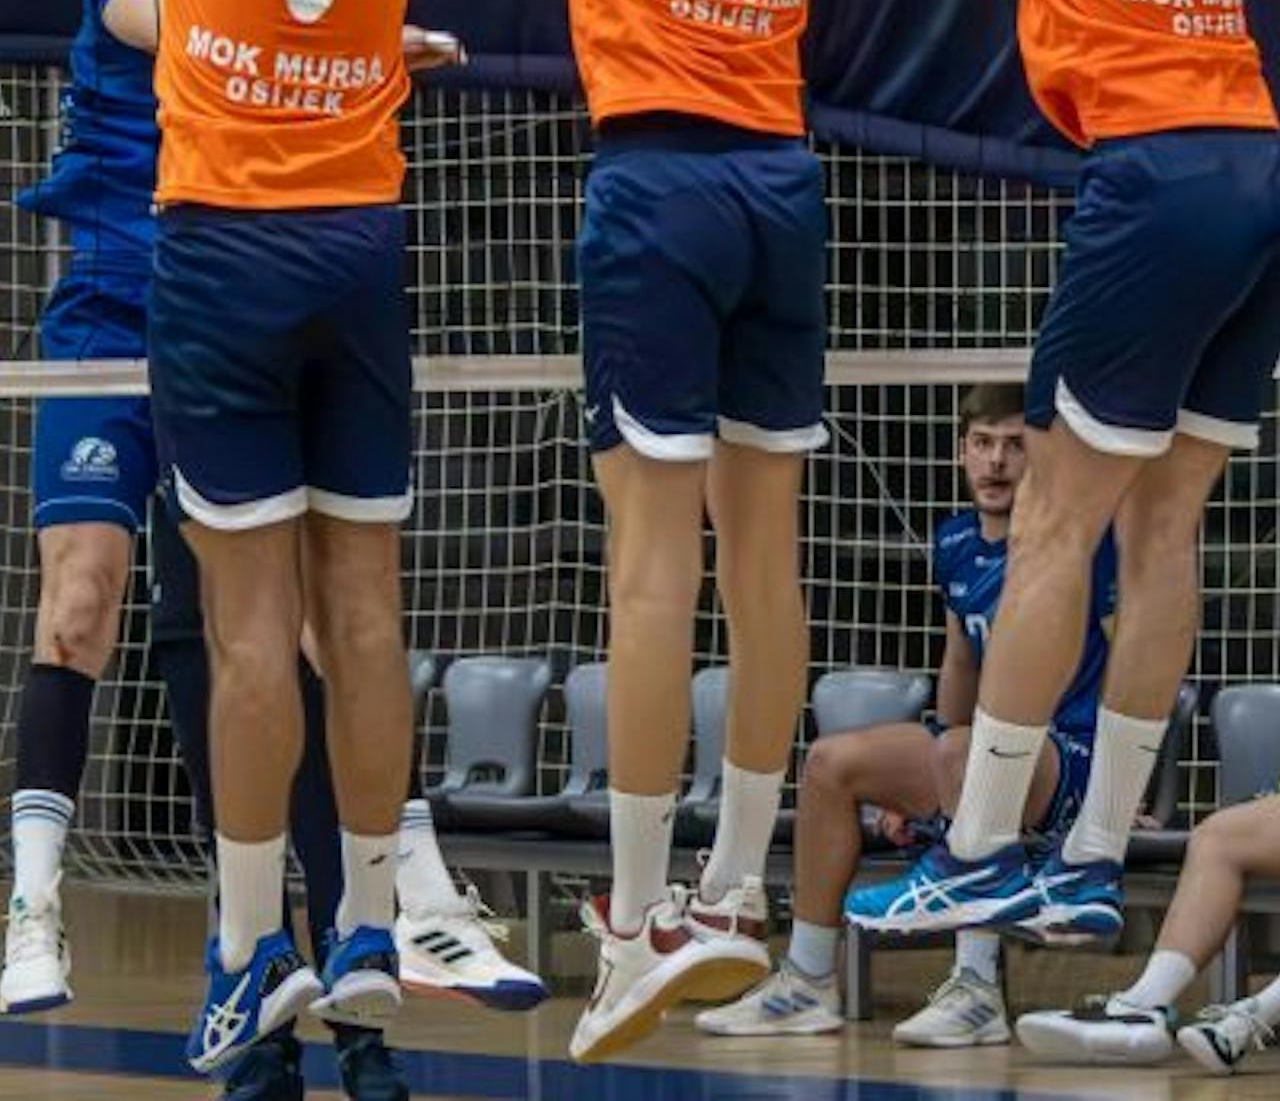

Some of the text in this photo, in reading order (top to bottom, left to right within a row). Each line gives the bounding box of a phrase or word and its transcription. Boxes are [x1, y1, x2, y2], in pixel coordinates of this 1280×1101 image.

[186, 24, 386, 90] MOK MURSA
[225, 76, 345, 117] OSIJEK
